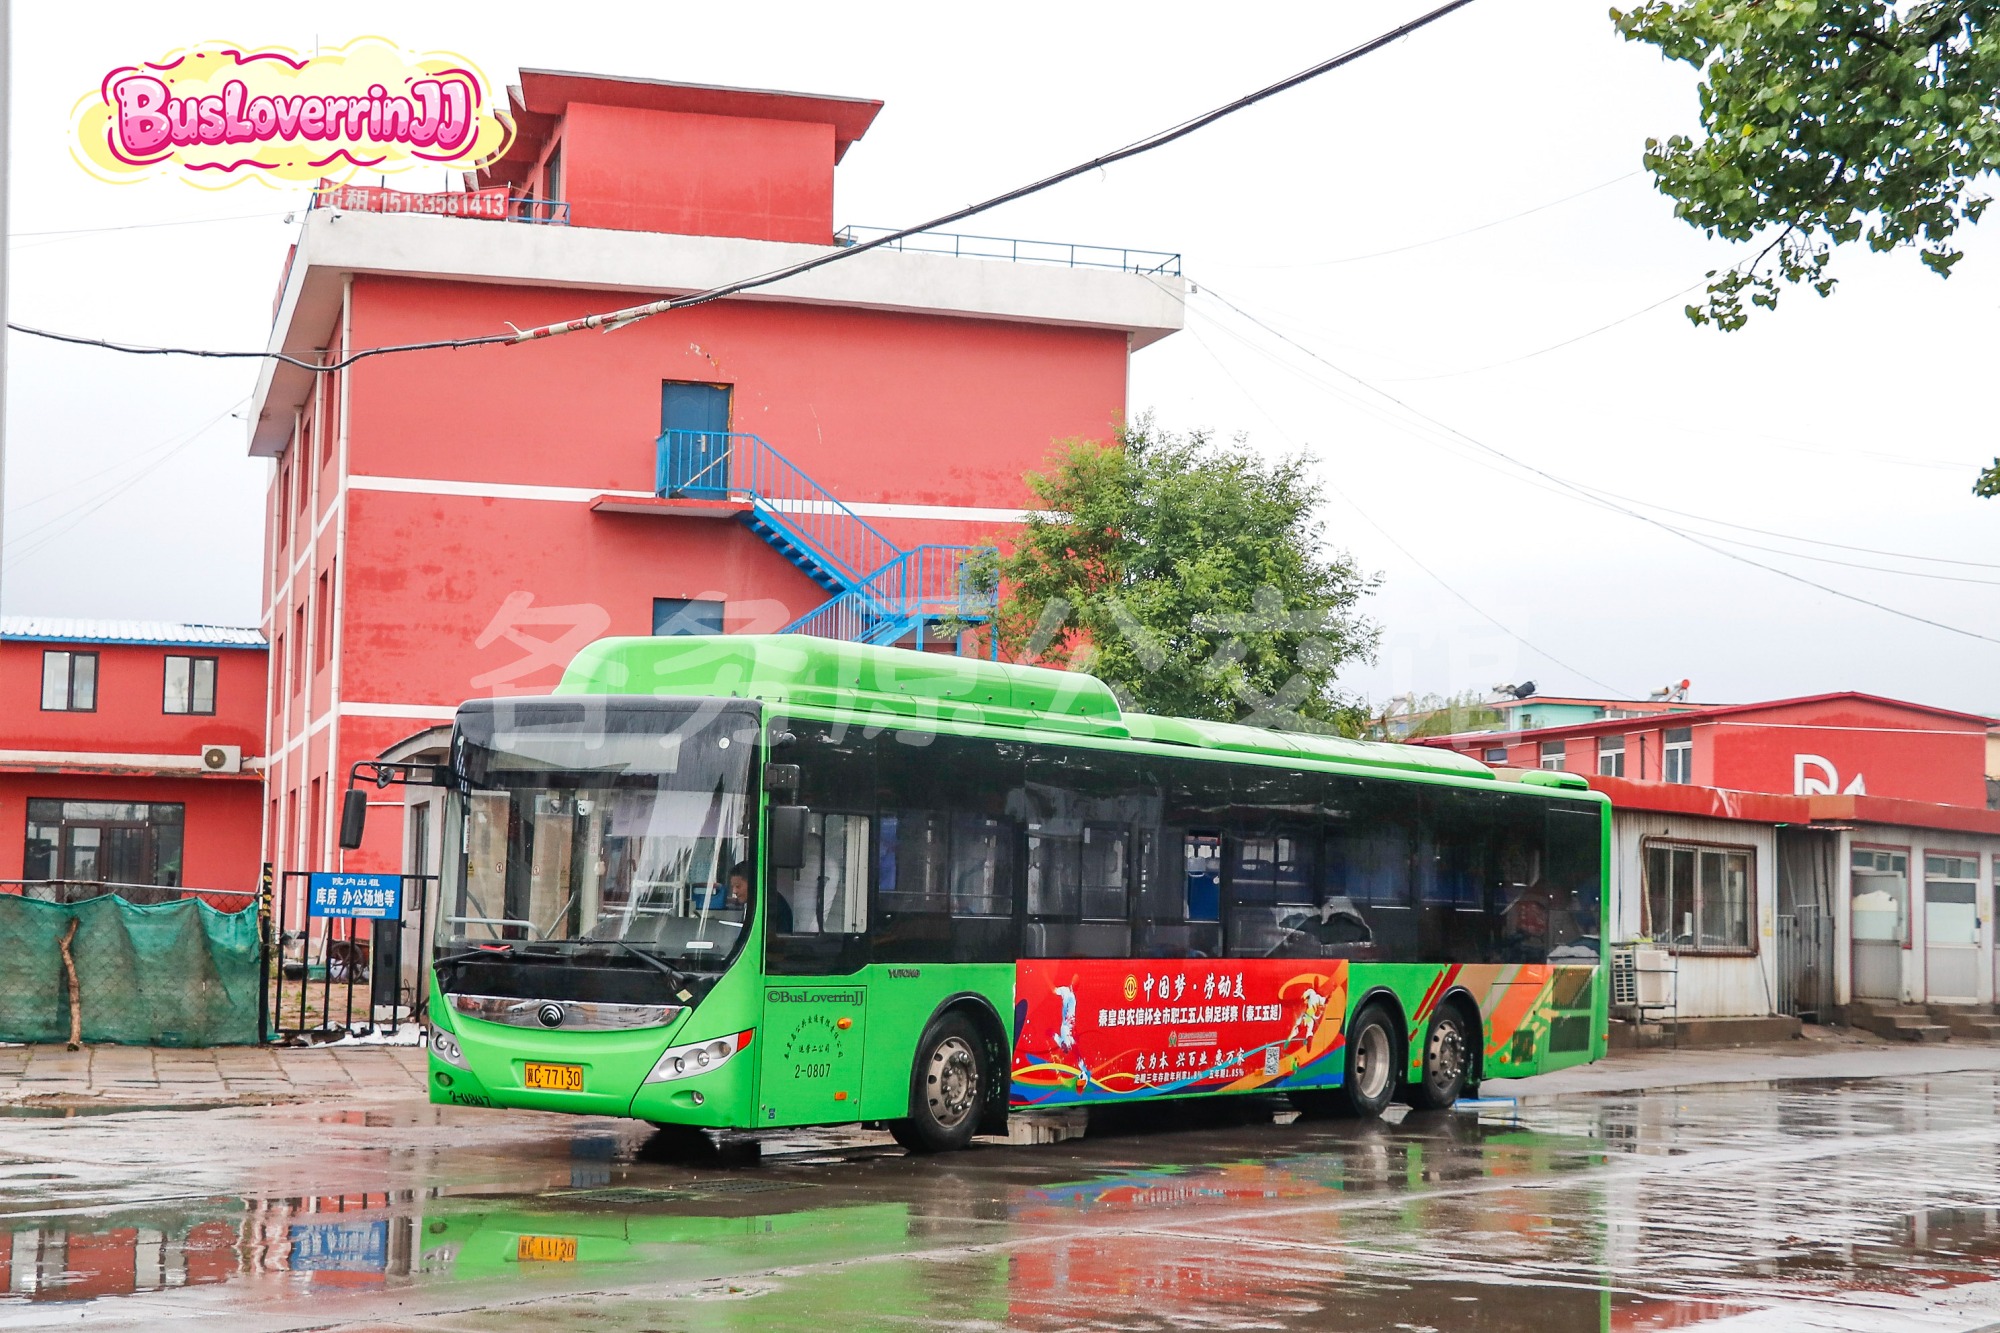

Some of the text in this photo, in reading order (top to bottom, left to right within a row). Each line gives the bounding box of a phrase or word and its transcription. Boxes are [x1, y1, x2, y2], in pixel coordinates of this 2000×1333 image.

[316, 887, 395, 907] 库房 办公场地等
[794, 1063, 831, 1079] 2-0807
[449, 1090, 492, 1108] 2-0807
